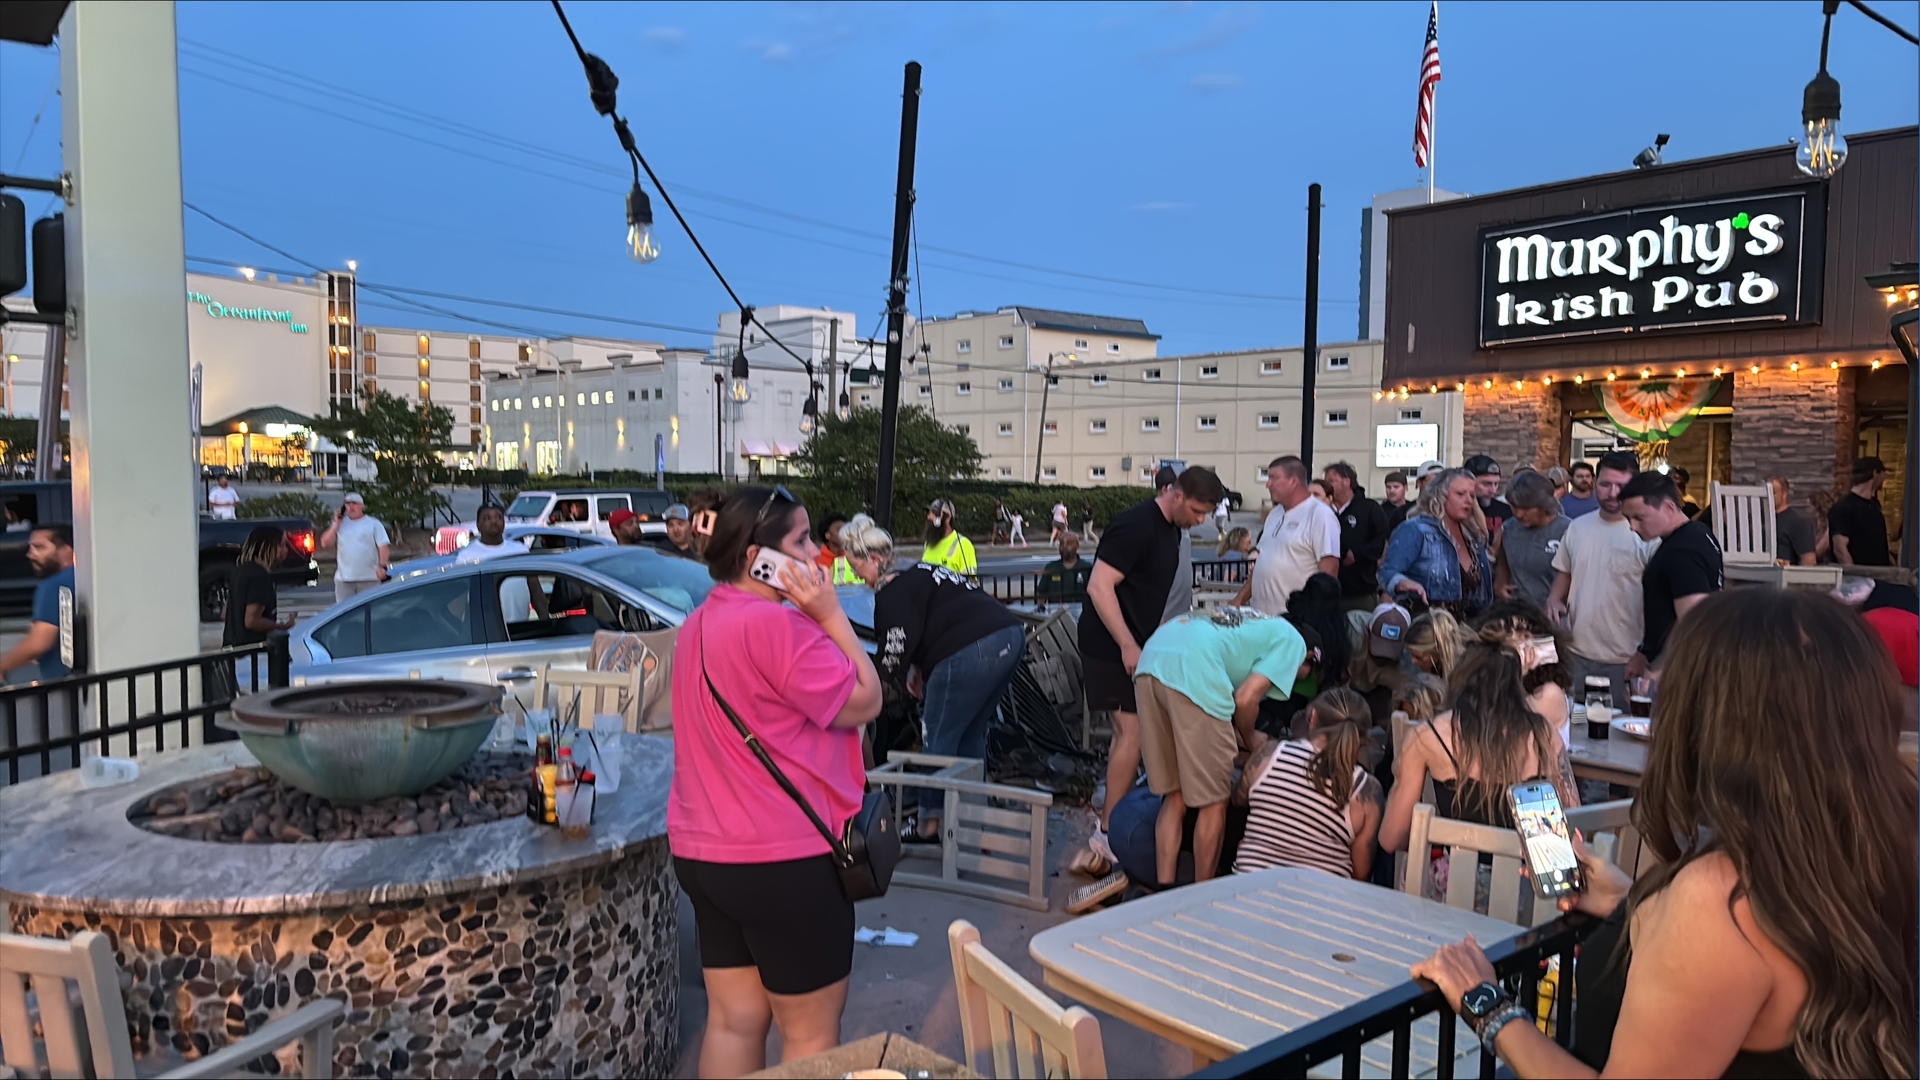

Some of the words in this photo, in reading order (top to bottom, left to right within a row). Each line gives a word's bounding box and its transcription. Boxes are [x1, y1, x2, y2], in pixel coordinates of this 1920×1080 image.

[1496, 211, 1784, 283] Murphy's
[207, 300, 292, 322] Oceanfront
[1496, 286, 1633, 327] Irish
[1651, 271, 1779, 313] Pub
[290, 321, 309, 333] Inn
